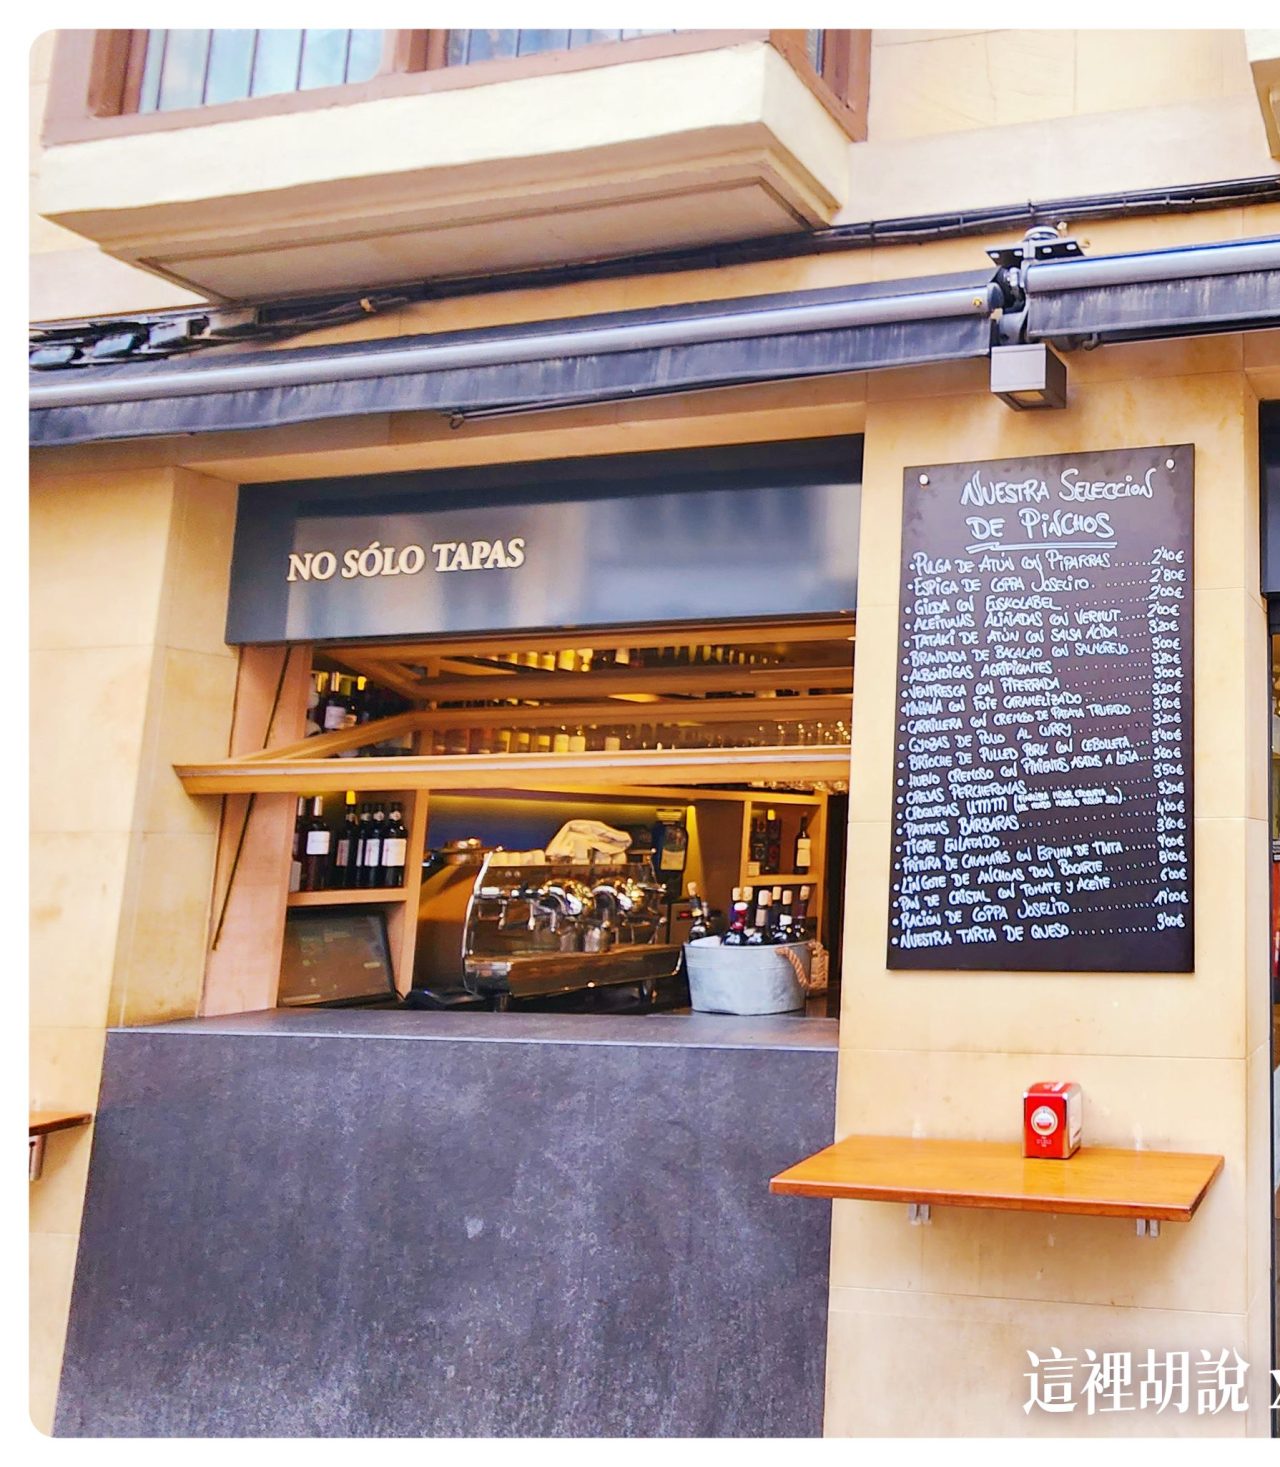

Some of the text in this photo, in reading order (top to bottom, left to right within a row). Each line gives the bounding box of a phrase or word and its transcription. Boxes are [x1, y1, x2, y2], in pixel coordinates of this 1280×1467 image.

[961, 470, 1050, 507] NUESTRA
[966, 508, 1115, 540] DE PINCHOS
[286, 538, 526, 582] NO SÓLO TAPAS
[913, 552, 952, 575] PULGA
[955, 560, 975, 573] DE
[978, 552, 1015, 572] ATÚN
[1021, 554, 1042, 571] CON
[1045, 549, 1111, 571] PIPARRAS
[914, 577, 959, 596] ESPIGA
[961, 579, 981, 592] DE
[991, 577, 1025, 592] COPPA
[1031, 575, 1089, 592] JOSELITO
[914, 598, 950, 615] GILDA
[956, 595, 974, 612] CON
[985, 595, 1062, 613] EUSKOLABEL
[914, 613, 975, 632] ACEITUNAS
[1049, 612, 1069, 626] CON
[1074, 608, 1121, 625] VERMUT
[911, 628, 956, 649] TATAKI
[959, 631, 980, 645] DE
[1025, 629, 1045, 643] CON
[1050, 628, 1082, 642] SALSA
[909, 650, 967, 667] BRANDADA
[971, 649, 990, 661] DE
[994, 645, 1043, 660] BACALAO
[1051, 644, 1069, 657] CON
[1075, 641, 1129, 656] SALMOREJO
[908, 684, 967, 699] VENTRESCA
[975, 680, 995, 695] CON
[948, 698, 966, 712] CON
[973, 695, 998, 711] FOIE
[907, 717, 963, 734] CARRILLERA
[970, 712, 987, 728] CON
[1035, 710, 1049, 721] DE
[1050, 707, 1085, 720] PATATA
[955, 735, 973, 748] DE
[976, 730, 1005, 745] POLLO
[1016, 728, 1032, 740] AL
[1039, 722, 1071, 737] CURRY
[908, 753, 952, 771] BRIOCHE
[955, 752, 973, 765] DE
[979, 747, 1018, 762] PULLED
[1022, 743, 1049, 758] PORK
[1056, 738, 1073, 753] CON
[908, 772, 940, 788] HUEVO
[947, 768, 994, 783] CREMOSO
[1000, 762, 1018, 777] CON
[1105, 754, 1113, 765] A
[906, 787, 945, 804] OREJAS
[903, 821, 949, 838] PATATAS
[903, 839, 936, 855] TIGRE
[944, 835, 999, 853] ENLATADO
[902, 856, 941, 874] FRITURA
[942, 854, 958, 871] DE
[1016, 847, 1032, 861] CON
[1037, 845, 1072, 861] ESPUMA
[1074, 844, 1089, 856] DE
[901, 875, 946, 894] LINGOTE
[951, 873, 970, 887] DE
[978, 866, 1025, 884] ANCHOAS
[1028, 862, 1054, 878] DON
[898, 896, 920, 911] PAN
[924, 894, 940, 908] DE
[949, 889, 991, 904] CRISTAL
[998, 882, 1015, 899] CON
[1020, 881, 1060, 897] TOMATE
[1066, 880, 1074, 894] Y
[945, 910, 962, 924] DE
[972, 905, 1008, 922] COPPA
[1018, 896, 1070, 918] JOSELITO
[900, 929, 952, 949] NUESTRA
[956, 926, 997, 943] TARTA
[1002, 925, 1024, 941] DE
[1031, 923, 1069, 939] QUESO
